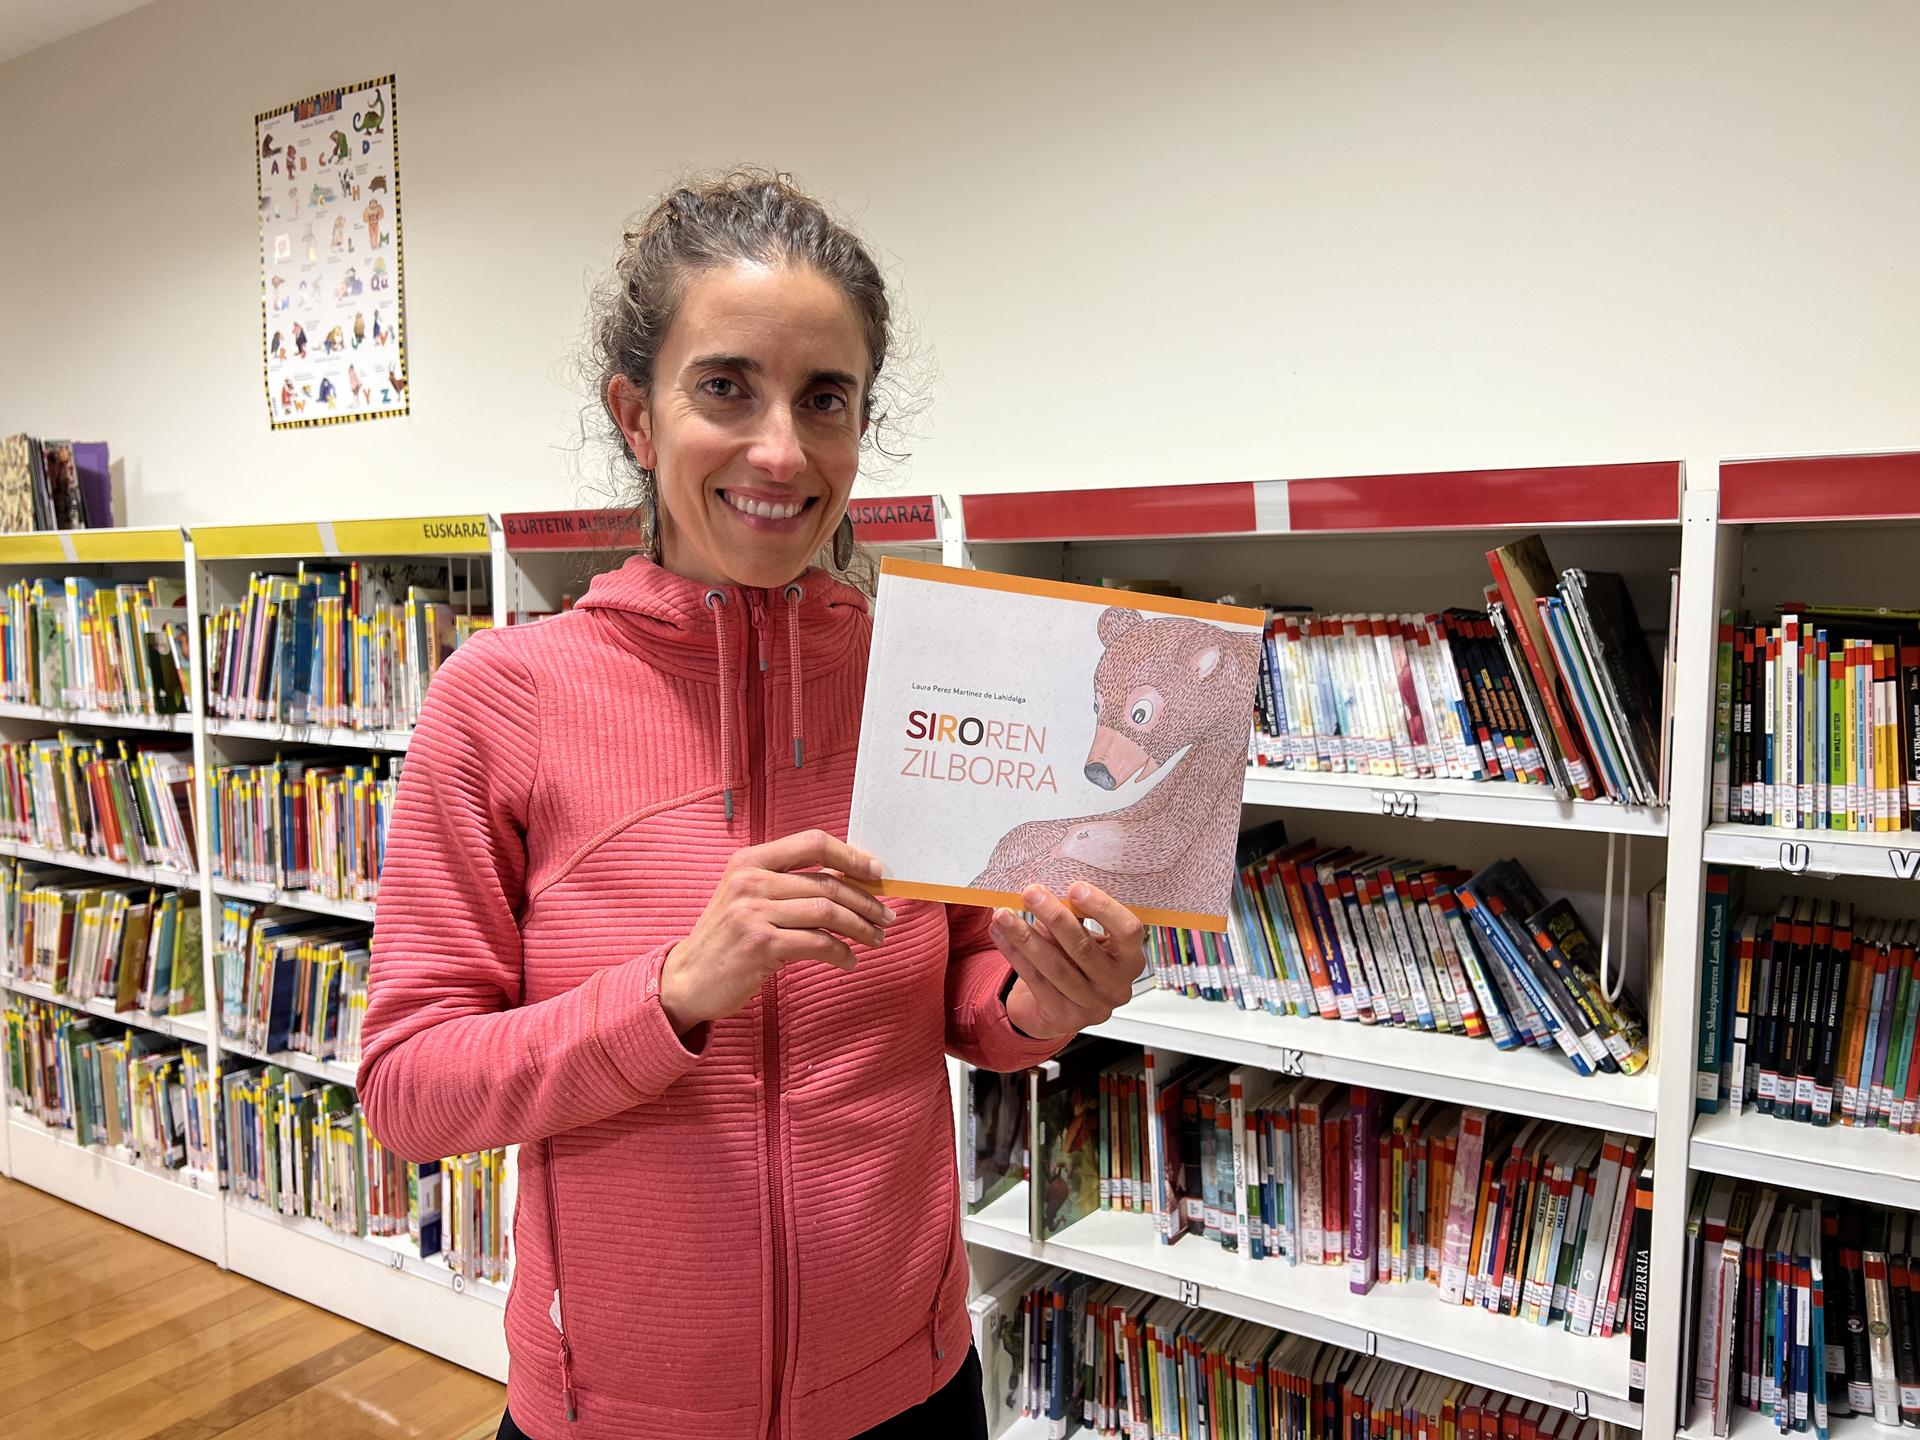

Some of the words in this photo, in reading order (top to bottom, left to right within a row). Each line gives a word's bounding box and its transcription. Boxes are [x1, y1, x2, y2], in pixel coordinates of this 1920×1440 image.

[362, 140, 370, 155] D
[271, 160, 279, 174] A
[379, 232, 389, 247] M
[371, 274, 388, 291] Qu
[294, 400, 306, 412] W
[381, 389, 391, 403] Z
[508, 520, 517, 535] 8
[518, 517, 574, 535] URTETIK
[849, 505, 933, 525] USKARAZ
[423, 521, 487, 539] EUSKARAZ
[912, 682, 931, 692] Laura
[933, 685, 951, 695] Perez
[994, 693, 1026, 704] Lahidalga
[906, 710, 1047, 754] SIROREN
[900, 748, 1058, 794] ZILBORRA
[1382, 792, 1417, 817] M
[1780, 842, 1810, 874] U
[1888, 849, 1920, 879] V
[1711, 904, 1722, 937] Onenak
[1710, 940, 1720, 964] Lanik
[1706, 966, 1719, 1031] Shakespeareren
[1704, 1033, 1715, 1064] William
[1282, 1049, 1304, 1075] K
[1354, 1114, 1362, 1143] Onenak
[1353, 1185, 1362, 1217] Erromako
[1353, 1230, 1362, 1257] Grezia
[452, 1274, 465, 1293] O
[1179, 1280, 1199, 1308] H
[1634, 1250, 1649, 1331] EGUBERRIA
[1572, 1390, 1589, 1420] J
